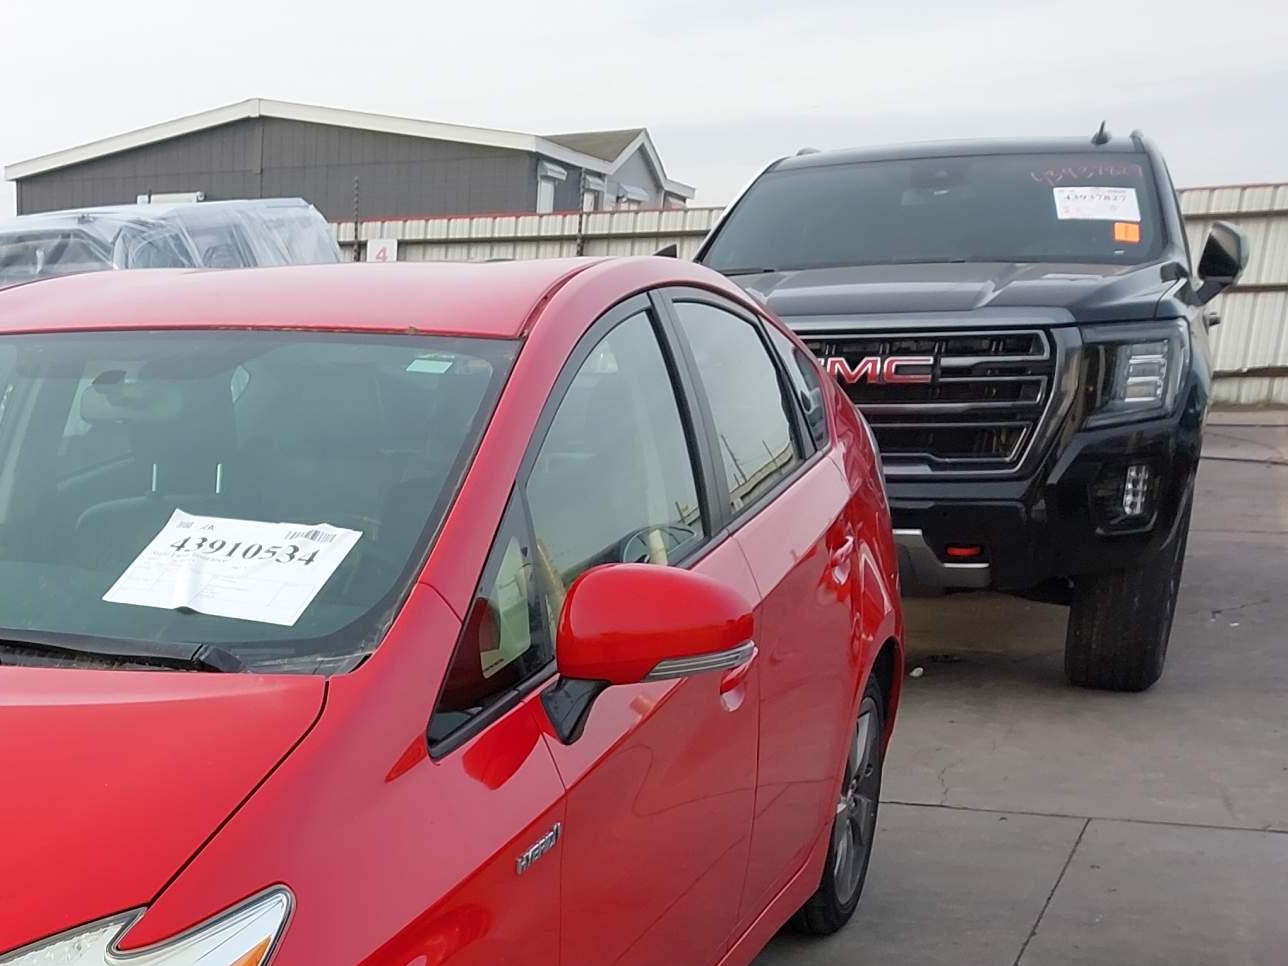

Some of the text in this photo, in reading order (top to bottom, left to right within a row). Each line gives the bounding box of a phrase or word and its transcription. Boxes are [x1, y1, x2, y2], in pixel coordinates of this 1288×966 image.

[376, 247, 388, 263] 4
[817, 356, 934, 384] MC
[169, 535, 321, 566] 43910534
